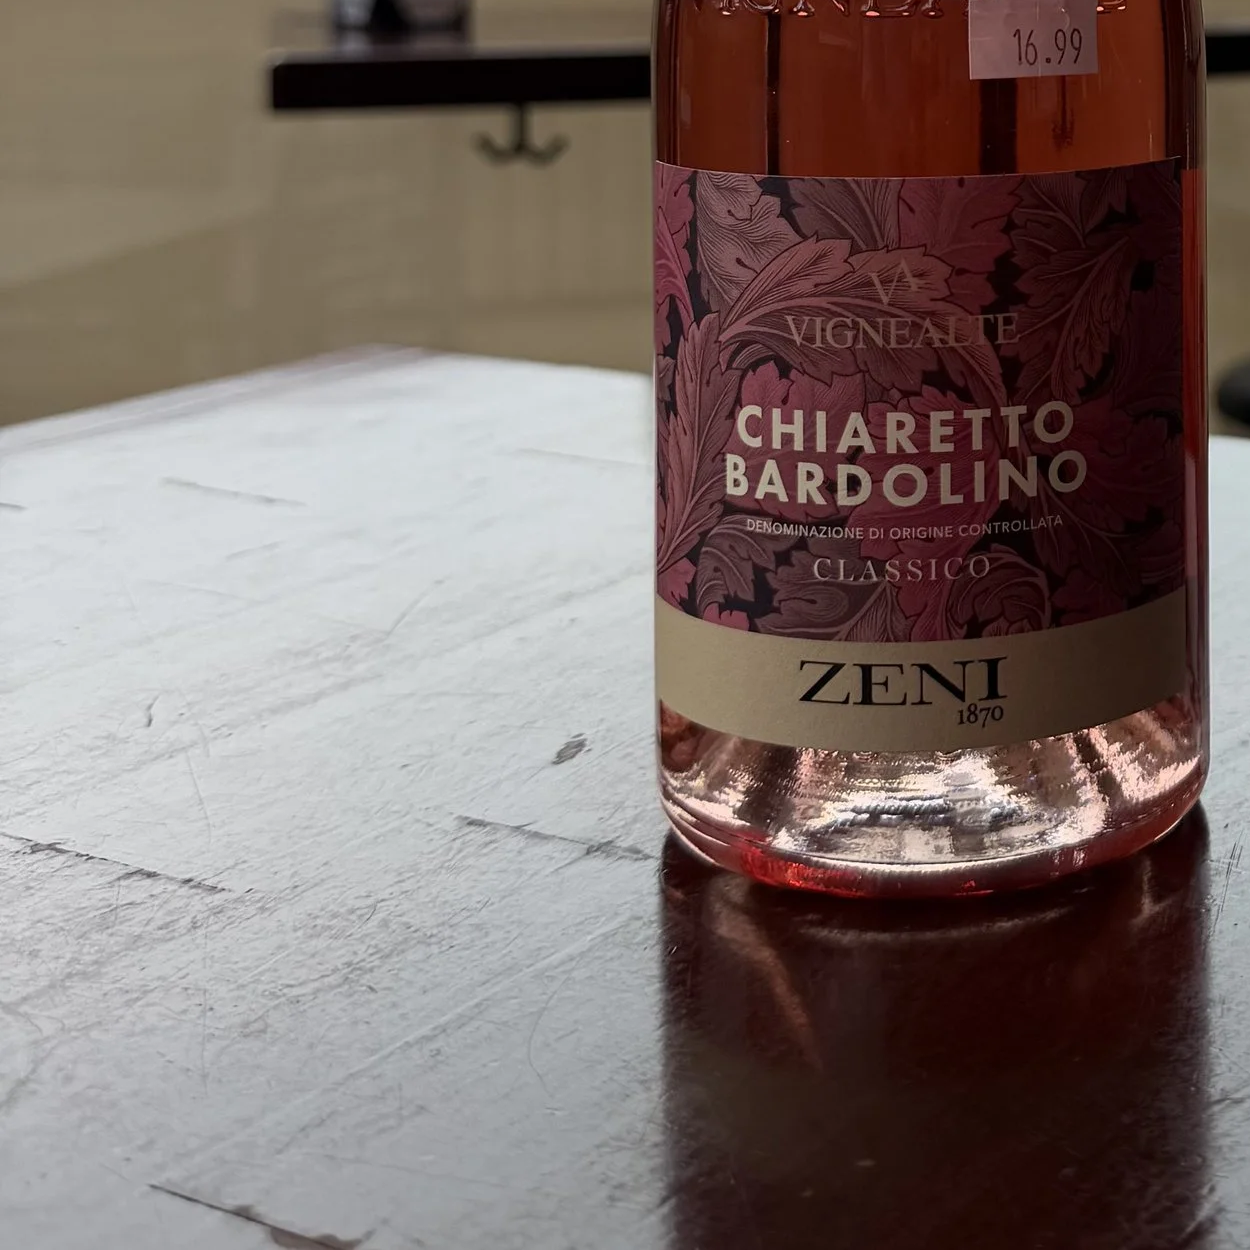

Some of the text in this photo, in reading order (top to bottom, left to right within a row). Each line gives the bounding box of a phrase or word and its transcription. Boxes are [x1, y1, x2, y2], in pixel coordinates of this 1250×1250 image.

[1012, 27, 1083, 66] 16.99
[784, 313, 1019, 348] VIGNEALTE
[736, 401, 1073, 454] CHIARETTO
[725, 450, 1087, 507] BARDOLINO
[746, 515, 1063, 540] DENOMINAZIONE DI ORIGINE CONTROLLATA
[813, 556, 991, 583] CLASSICO
[799, 657, 1008, 706] ZENI
[957, 702, 1003, 728] 1870
